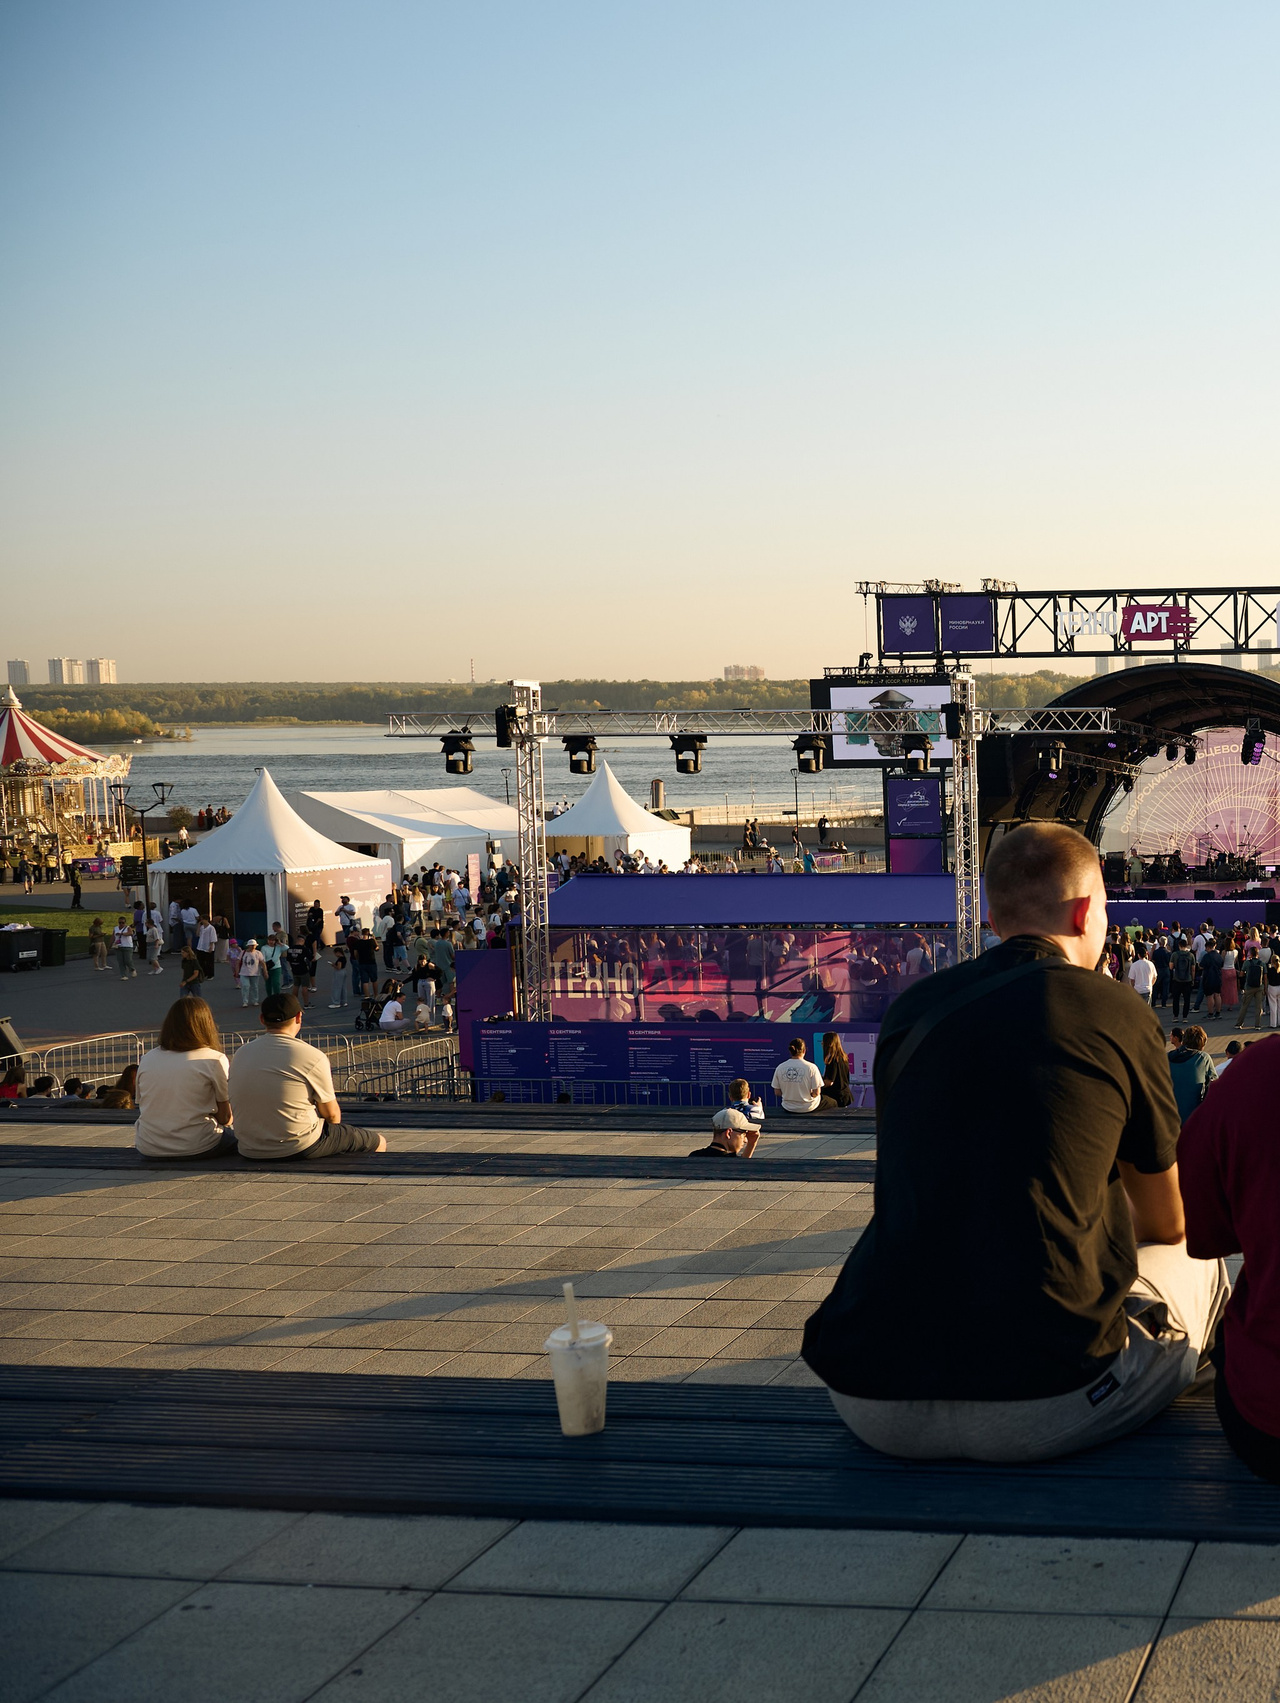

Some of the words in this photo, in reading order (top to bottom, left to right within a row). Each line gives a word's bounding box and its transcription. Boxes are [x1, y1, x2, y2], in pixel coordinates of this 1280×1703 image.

[1056, 611, 1118, 636] ТЕХНО
[1129, 611, 1170, 634] АРТ
[1120, 765, 1174, 834] СИБИРСКИЙ
[549, 961, 640, 1000] ТЕХНО
